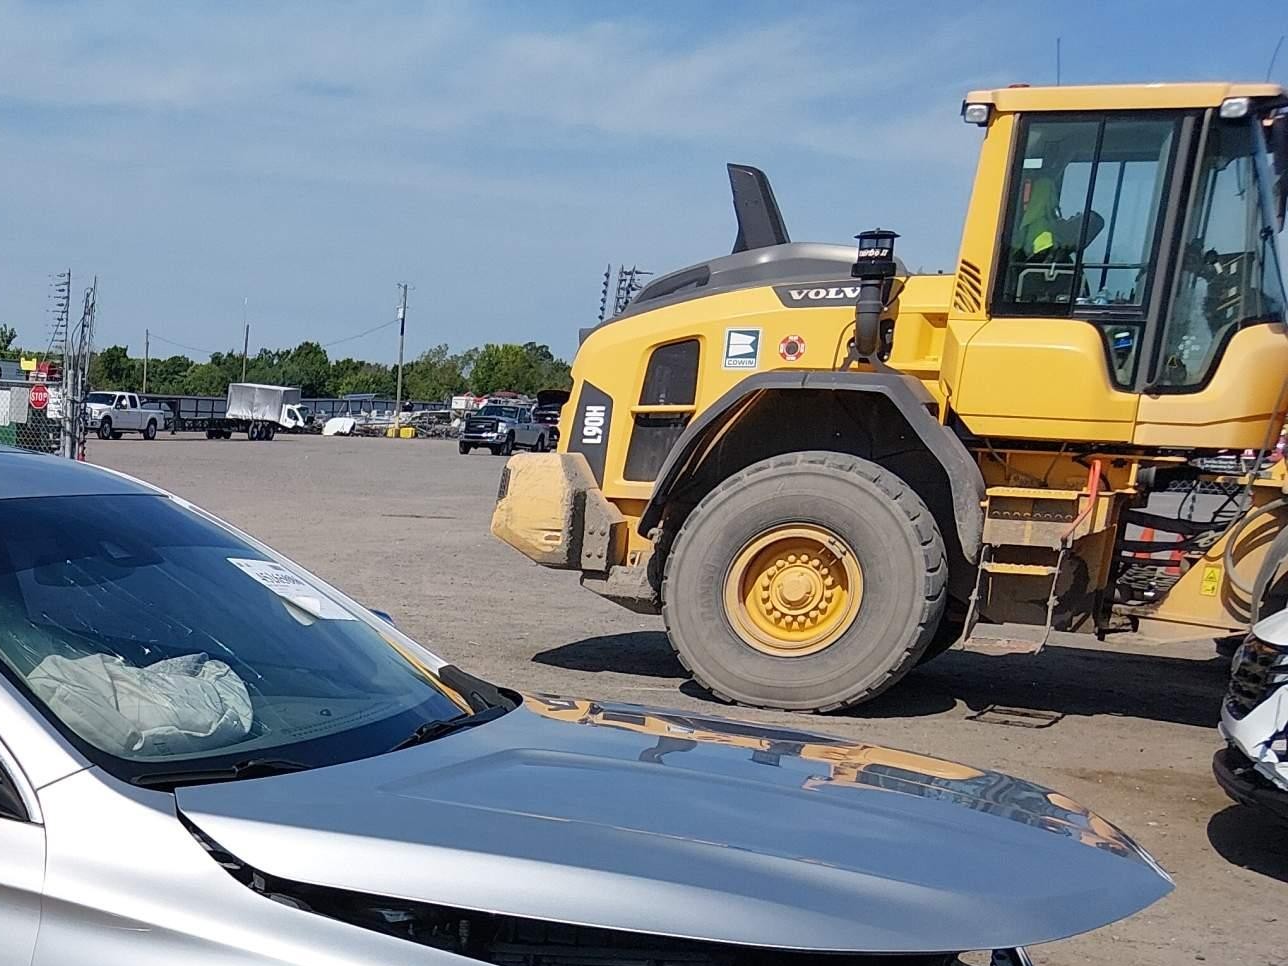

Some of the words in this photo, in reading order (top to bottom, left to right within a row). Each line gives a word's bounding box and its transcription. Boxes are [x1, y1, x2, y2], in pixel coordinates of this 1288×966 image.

[788, 287, 861, 300] VOLV
[32, 392, 48, 401] STOP
[582, 405, 606, 444] L90H
